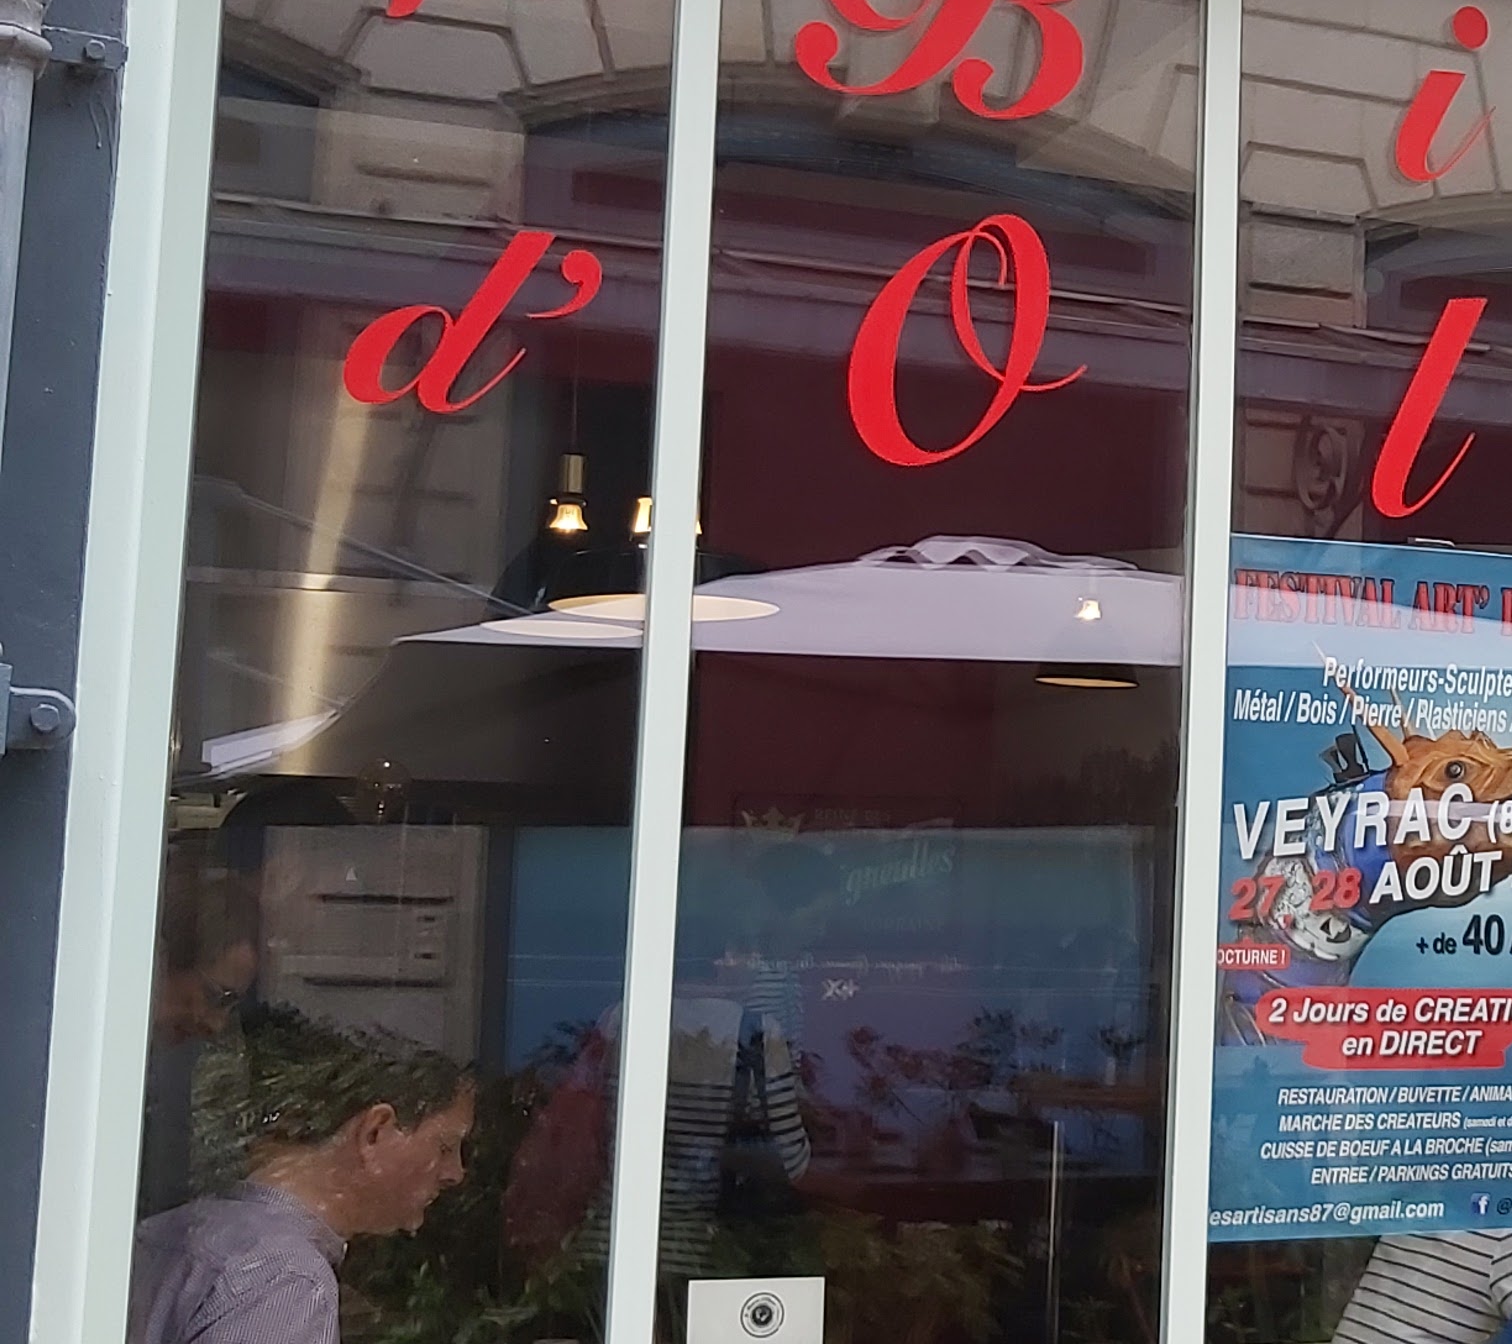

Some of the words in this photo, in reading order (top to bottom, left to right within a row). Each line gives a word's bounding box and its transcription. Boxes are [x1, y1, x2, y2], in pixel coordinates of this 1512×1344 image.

[1234, 568, 1400, 630] FESTIVAL
[1233, 688, 1282, 722] Métal
[1296, 694, 1337, 725] Bois
[1351, 696, 1401, 728] Pierre
[1416, 699, 1507, 735] Plasticiens
[1234, 783, 1473, 859] VEYRAC
[1309, 867, 1362, 910] 28
[1369, 845, 1503, 904] AOÛT
[1416, 937, 1429, 954] +
[1432, 932, 1457, 955] de
[1462, 913, 1505, 956] 40
[1268, 998, 1288, 1023] 2
[1293, 997, 1369, 1023] Jours
[1375, 998, 1407, 1023] de
[1342, 1036, 1373, 1056] en
[1379, 1030, 1482, 1056] DIRECT
[1278, 1087, 1389, 1106] RESTAURATION
[1397, 1086, 1462, 1104] BUVETTE
[1279, 1114, 1342, 1133] MARCHE
[1344, 1113, 1374, 1131] DES
[1377, 1112, 1462, 1131] CREATEURS
[1260, 1141, 1314, 1160] CUISSE
[1316, 1141, 1338, 1158] DE
[1339, 1140, 1391, 1158] BOEUF
[1391, 1139, 1402, 1156] A
[1403, 1139, 1423, 1155] LA
[1425, 1138, 1485, 1155] BROCHE
[1311, 1167, 1369, 1185] ENTREE
[1377, 1164, 1449, 1183] PARKINGS
